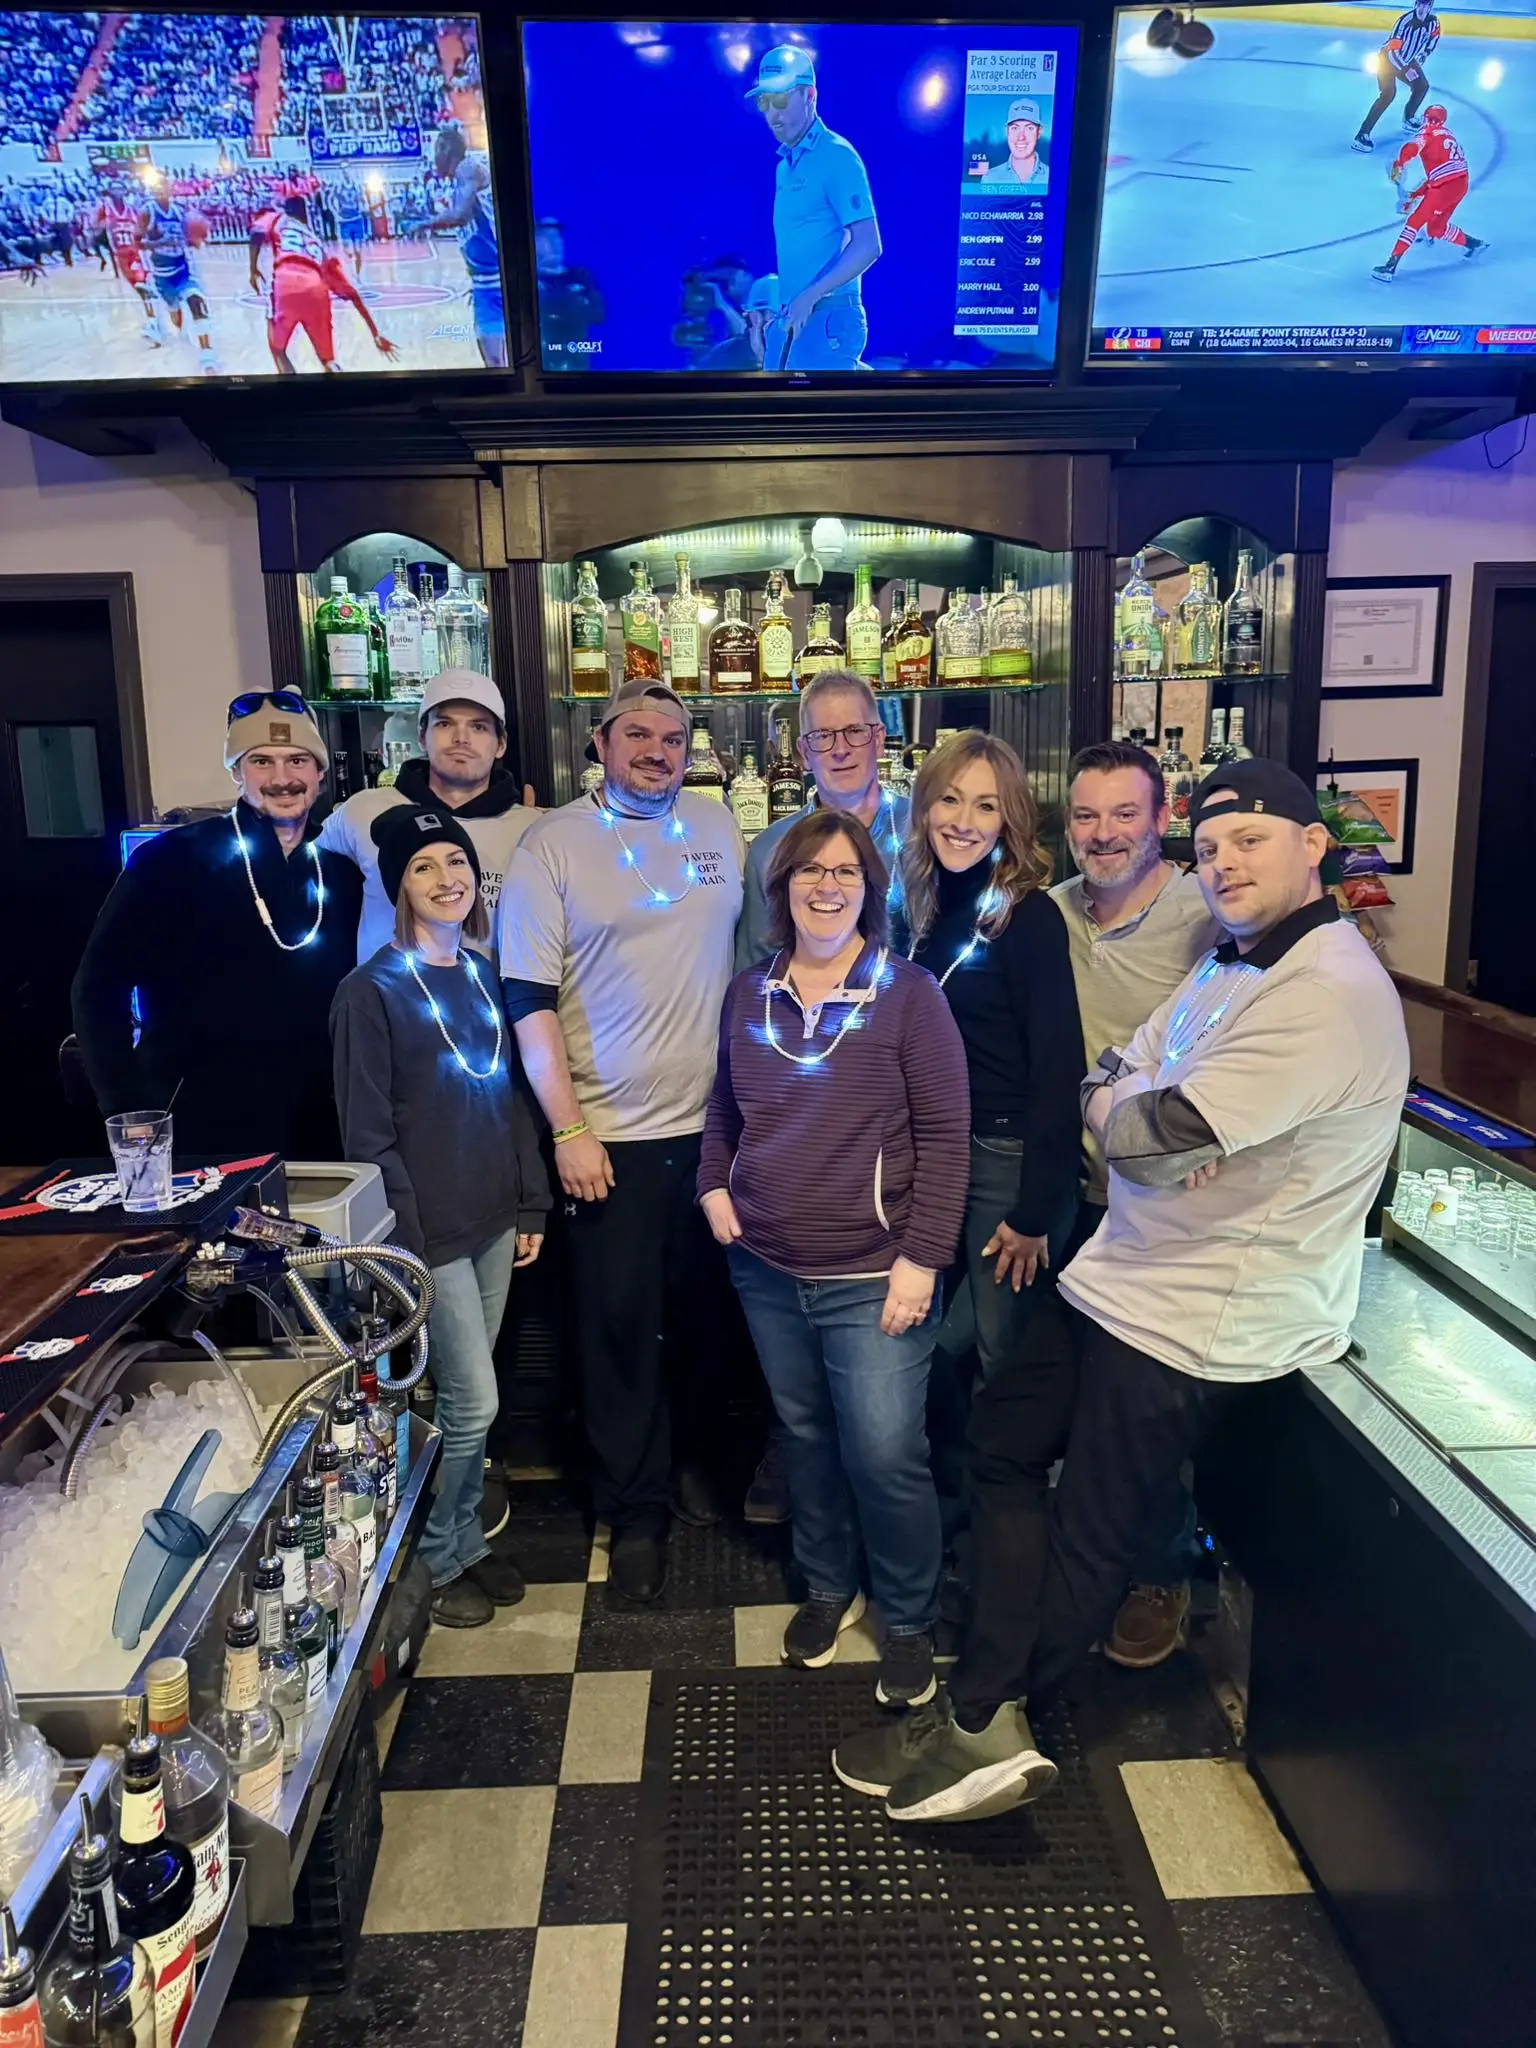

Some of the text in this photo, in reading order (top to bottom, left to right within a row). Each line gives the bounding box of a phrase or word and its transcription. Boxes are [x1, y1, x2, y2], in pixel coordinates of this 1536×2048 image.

[970, 55, 1037, 69] Par 3 Scoring
[970, 69, 1037, 82] Average Leaders
[972, 153, 987, 161] USA
[981, 185, 1028, 193] BEN GRIFFIN
[961, 212, 1044, 220] NICO ECHAVARRIA 2.98
[960, 235, 1043, 244] BEN GRIFFIN 2.99
[959, 257, 1041, 266] ERIC COLE 2.99
[958, 283, 1040, 291] HARRY HALL 3.00
[957, 307, 1037, 315] ANDREW PUTNAM 3.01
[1136, 329, 1148, 338] TB
[1168, 330, 1194, 338] 7:00 ET
[1202, 327, 1367, 338] TB: 14-GAME POINT STREAK (13-0-1)
[548, 341, 598, 351] LIVE GOLF
[1171, 339, 1190, 347] ESPN
[1206, 339, 1219, 348] (18
[1220, 338, 1250, 347] GAMES
[1252, 338, 1261, 347] IN
[1262, 338, 1298, 348] 2003-04,
[1300, 338, 1311, 347] 16
[1313, 338, 1343, 347] GAMES
[1345, 338, 1355, 347] IN
[1355, 338, 1393, 348] 2018-19)
[672, 627, 693, 636] HIGH
[852, 625, 880, 636] JAMESON
[672, 635, 693, 643] WEST
[772, 781, 801, 793] JAMESON
[697, 863, 719, 873] OFF
[698, 874, 726, 886] MAIN
